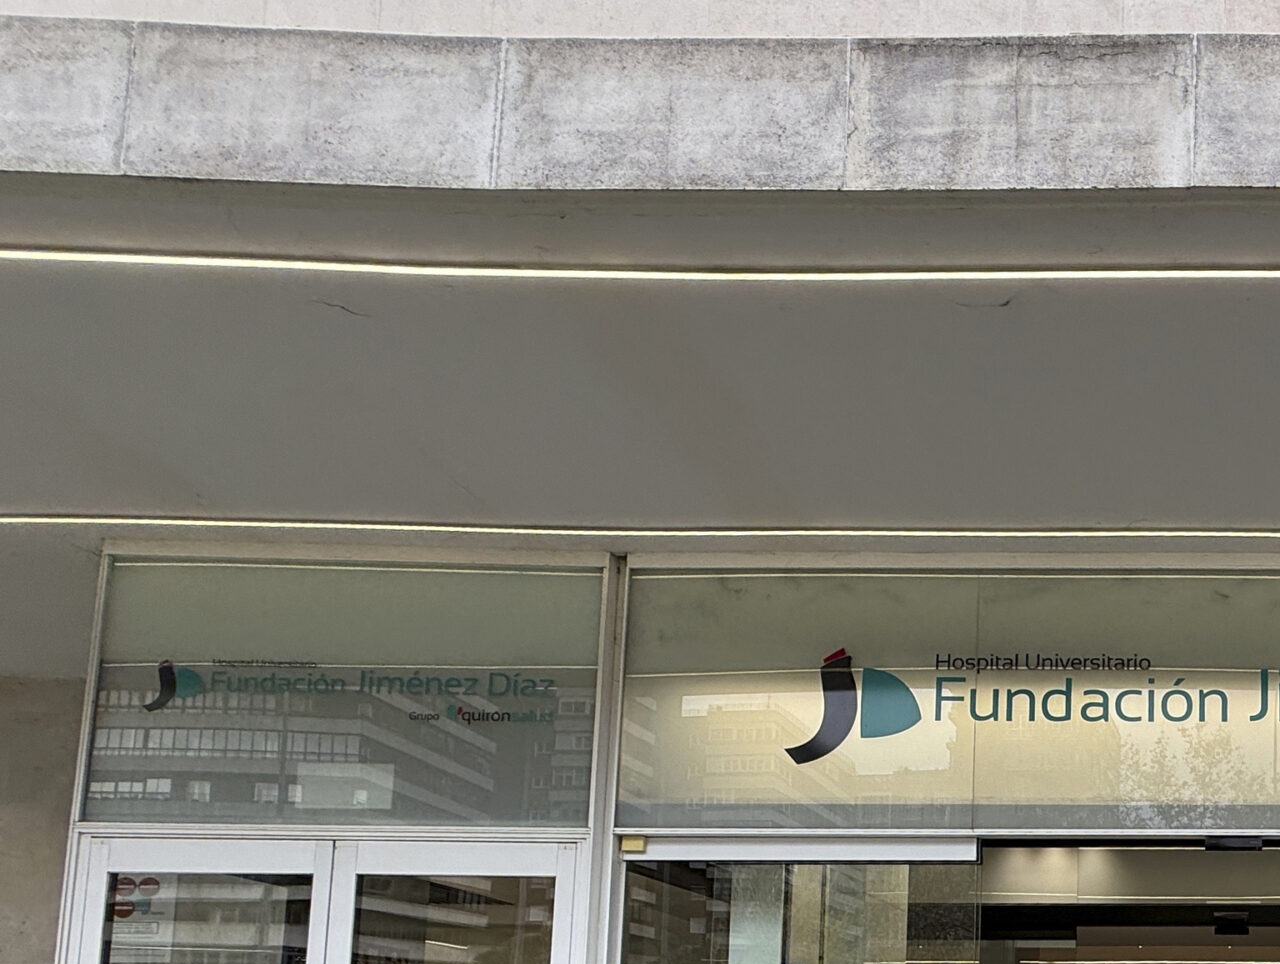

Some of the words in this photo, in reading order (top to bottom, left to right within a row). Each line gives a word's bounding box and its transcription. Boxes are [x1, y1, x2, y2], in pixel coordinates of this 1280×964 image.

[935, 654, 1019, 674] Hospital
[1025, 654, 1151, 671] Universitario
[210, 671, 346, 694] Fundación
[356, 670, 479, 696] Jiménez
[487, 672, 557, 697] Díaz
[935, 676, 1229, 723] Fundación
[408, 711, 440, 722] Grupo
